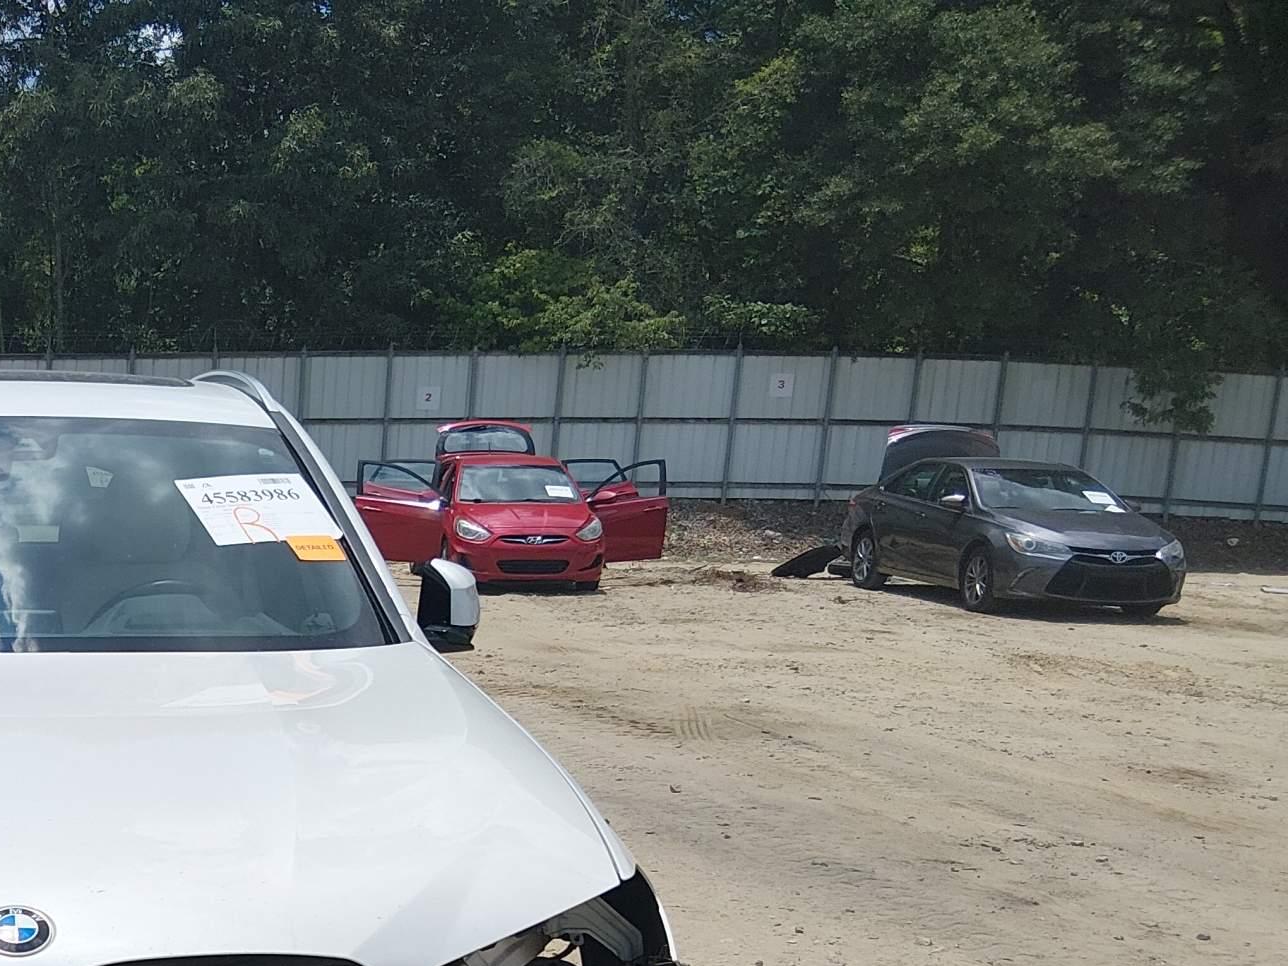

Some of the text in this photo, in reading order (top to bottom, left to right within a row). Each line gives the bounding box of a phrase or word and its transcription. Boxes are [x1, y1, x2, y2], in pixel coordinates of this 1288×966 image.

[777, 380, 785, 389] 3
[425, 393, 432, 402] 2
[201, 488, 300, 504] 45583986
[232, 506, 280, 544] R
